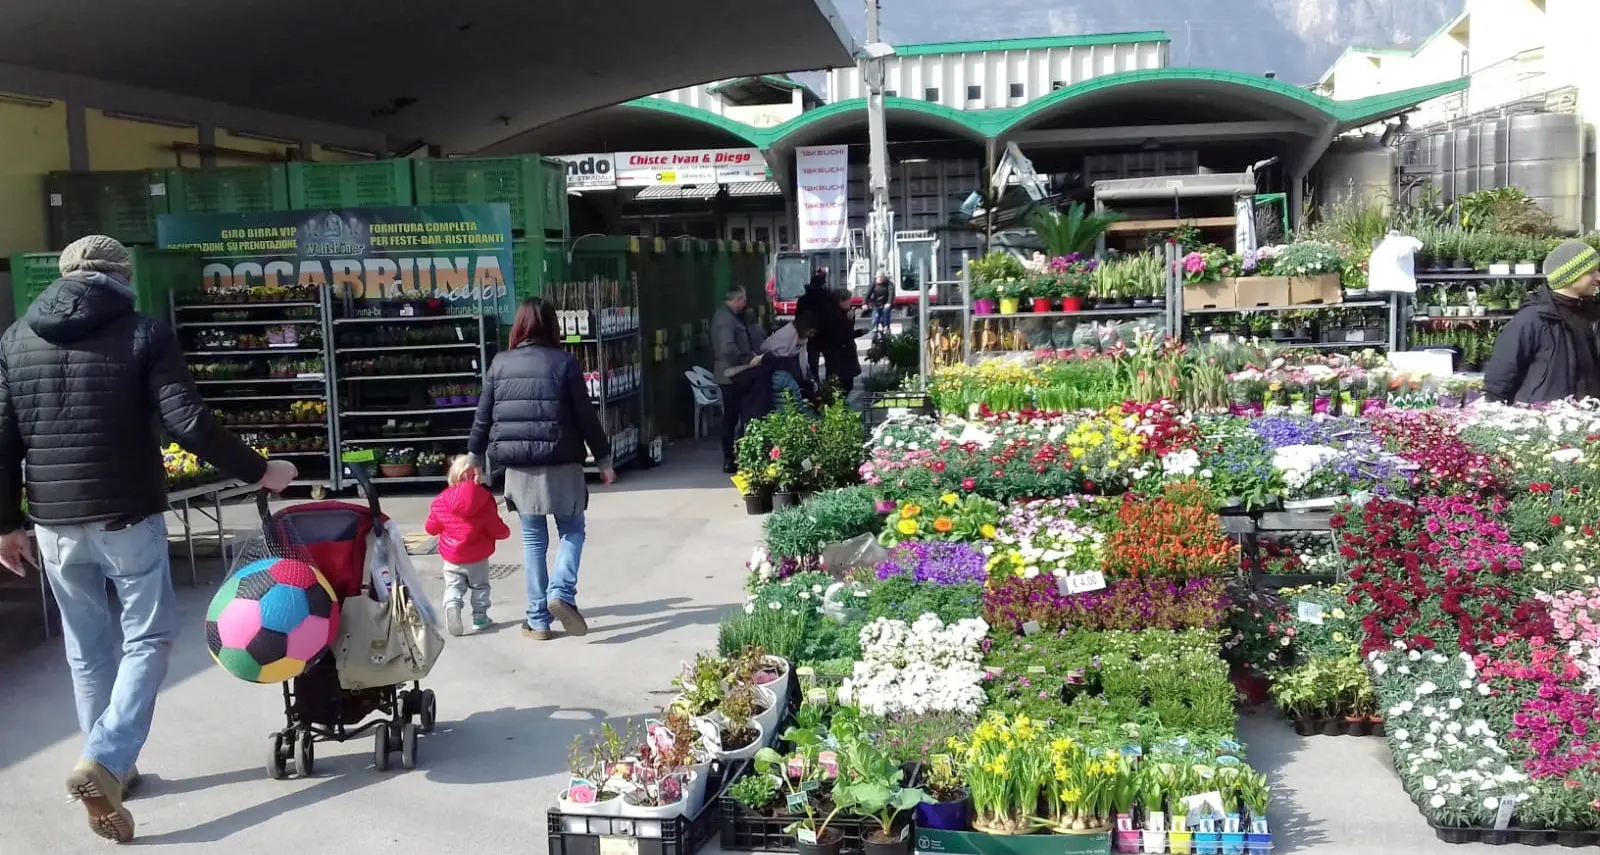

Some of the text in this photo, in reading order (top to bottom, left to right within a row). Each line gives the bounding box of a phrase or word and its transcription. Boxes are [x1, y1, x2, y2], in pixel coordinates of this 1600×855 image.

[672, 154, 698, 165] Ivan
[702, 153, 711, 163] &
[714, 152, 751, 164] Diego
[220, 226, 297, 240] GIRO BIRRA VIP
[369, 221, 477, 234] FORNITURA COMPLETA
[226, 241, 238, 251] SU
[239, 240, 298, 251] PRENOTAZIONE
[369, 233, 504, 246] PER FESTE-BAR-RISTORANTI
[202, 257, 505, 298] OCCABRUNA
